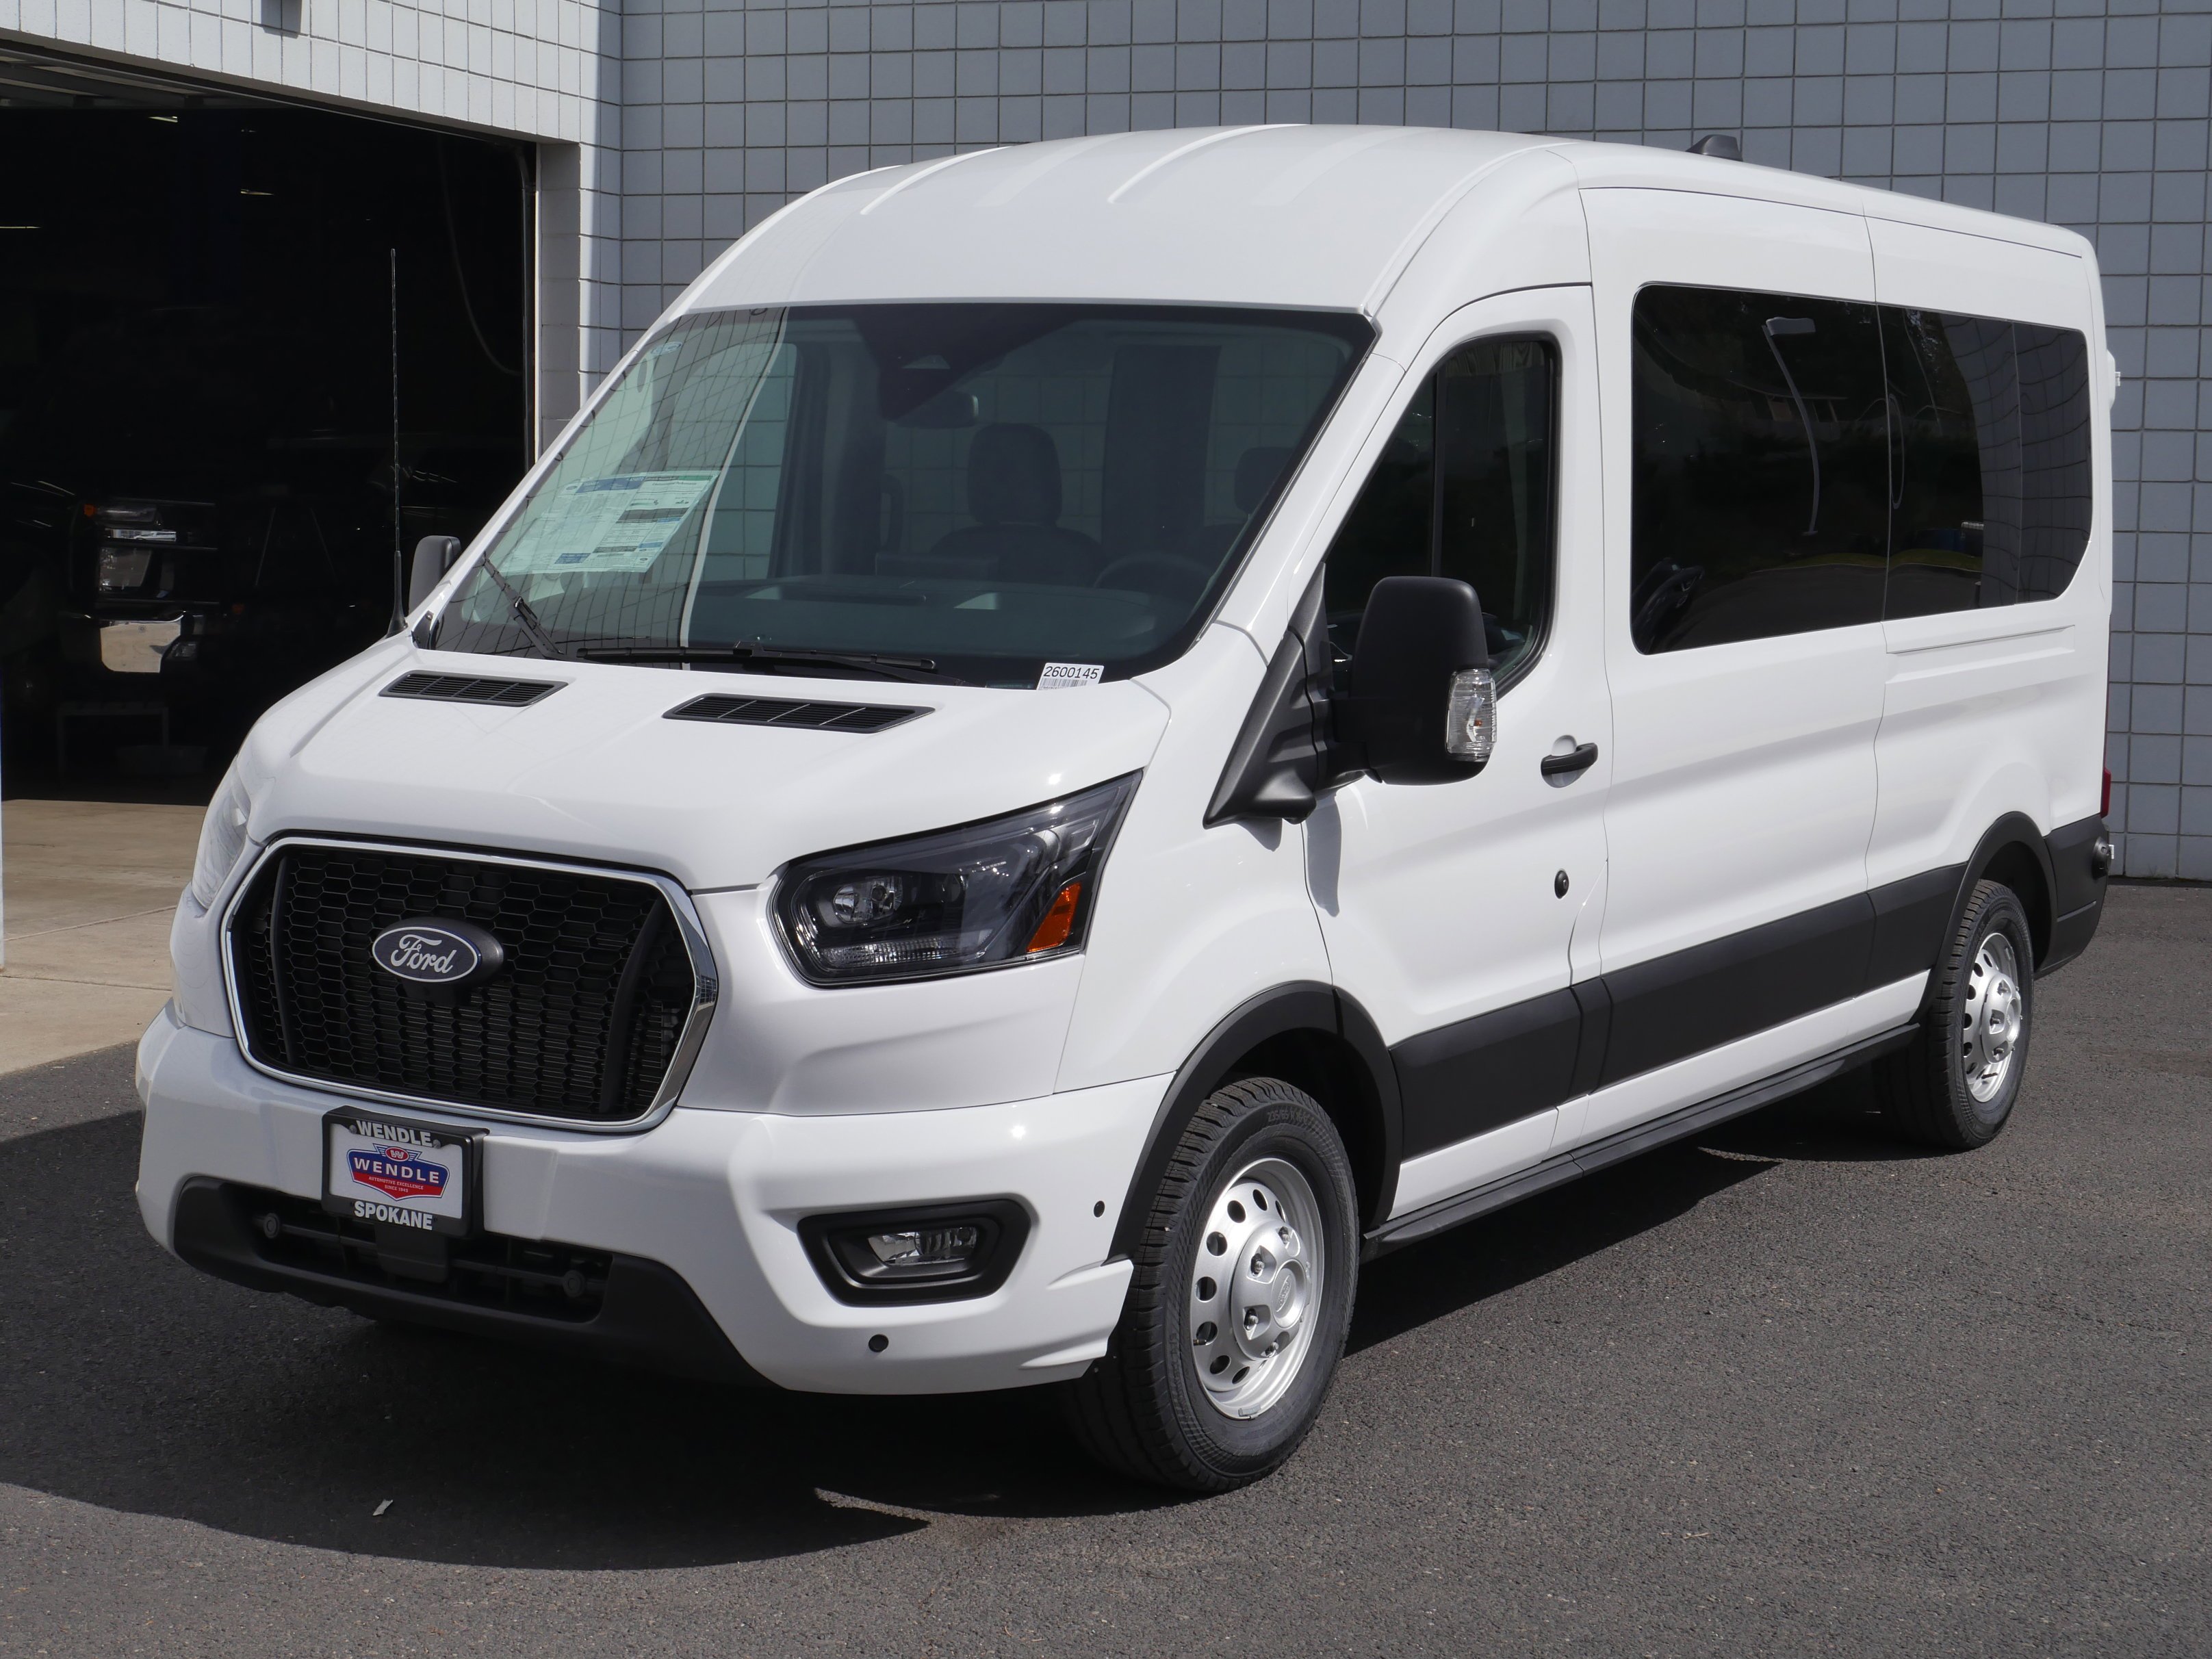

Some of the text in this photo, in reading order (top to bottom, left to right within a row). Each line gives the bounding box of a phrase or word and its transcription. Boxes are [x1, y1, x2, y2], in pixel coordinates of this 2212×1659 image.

[1044, 666, 1099, 679] 2600145
[391, 934, 456, 973] Ford
[356, 1120, 433, 1147] WENDLE
[354, 1157, 439, 1183] WENDLE
[368, 1176, 424, 1189] AUTOMOTIVE EXCELLENCE
[354, 1200, 433, 1230] SPOKANE
